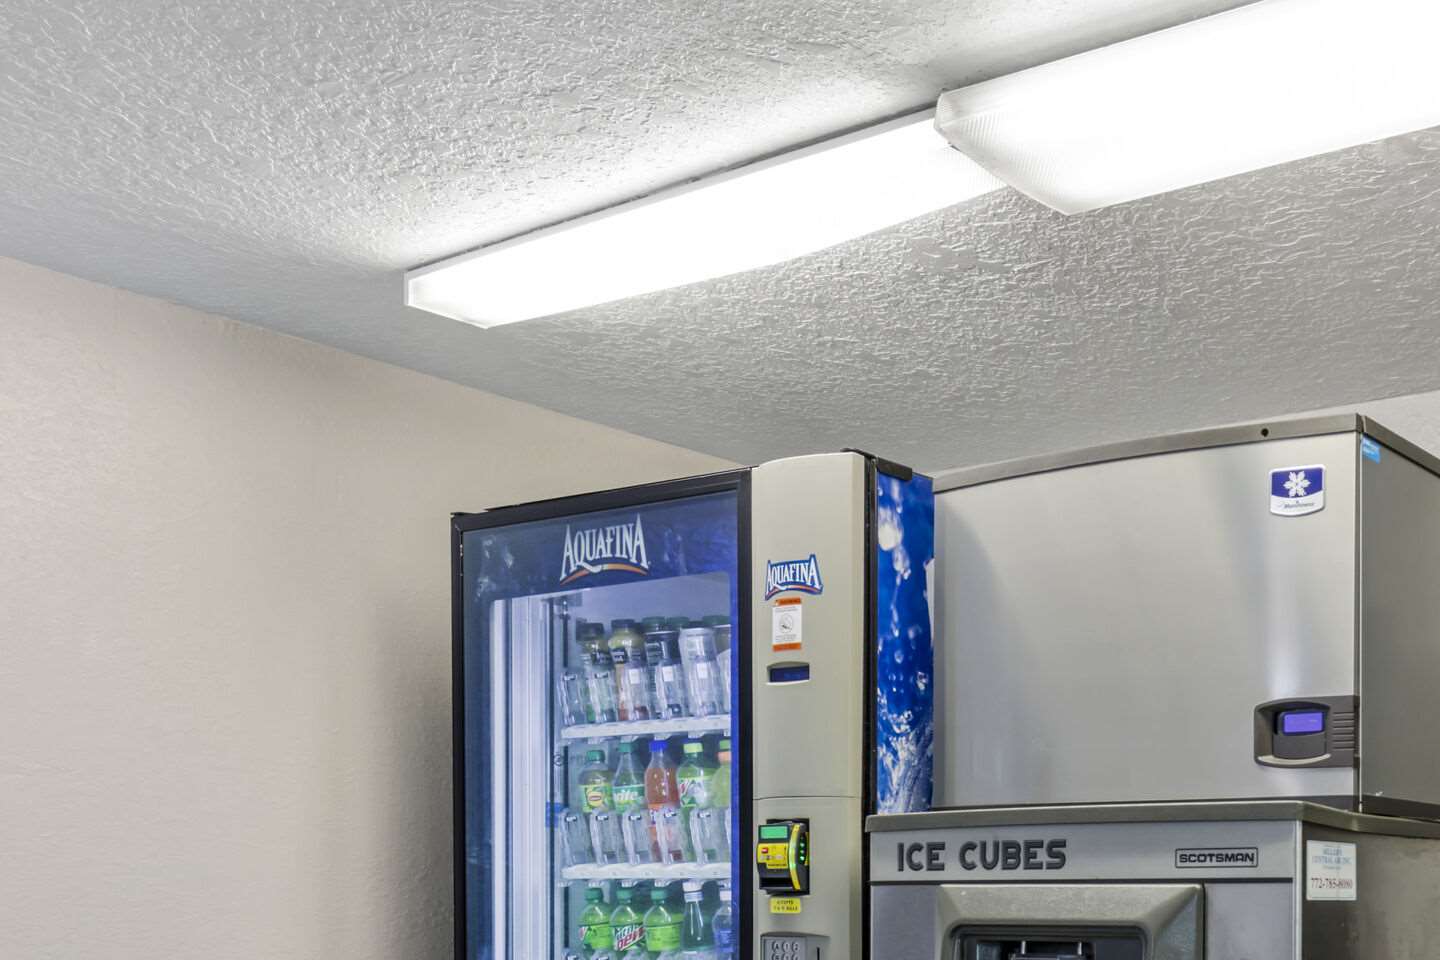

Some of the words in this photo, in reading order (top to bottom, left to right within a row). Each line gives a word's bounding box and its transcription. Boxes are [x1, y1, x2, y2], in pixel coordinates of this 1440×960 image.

[560, 512, 649, 578] AQUAFINA
[766, 556, 821, 596] AQUAFINA
[897, 841, 946, 872] ICE
[959, 839, 1067, 871] CUBES
[1179, 853, 1255, 864] SCOTSMAN
